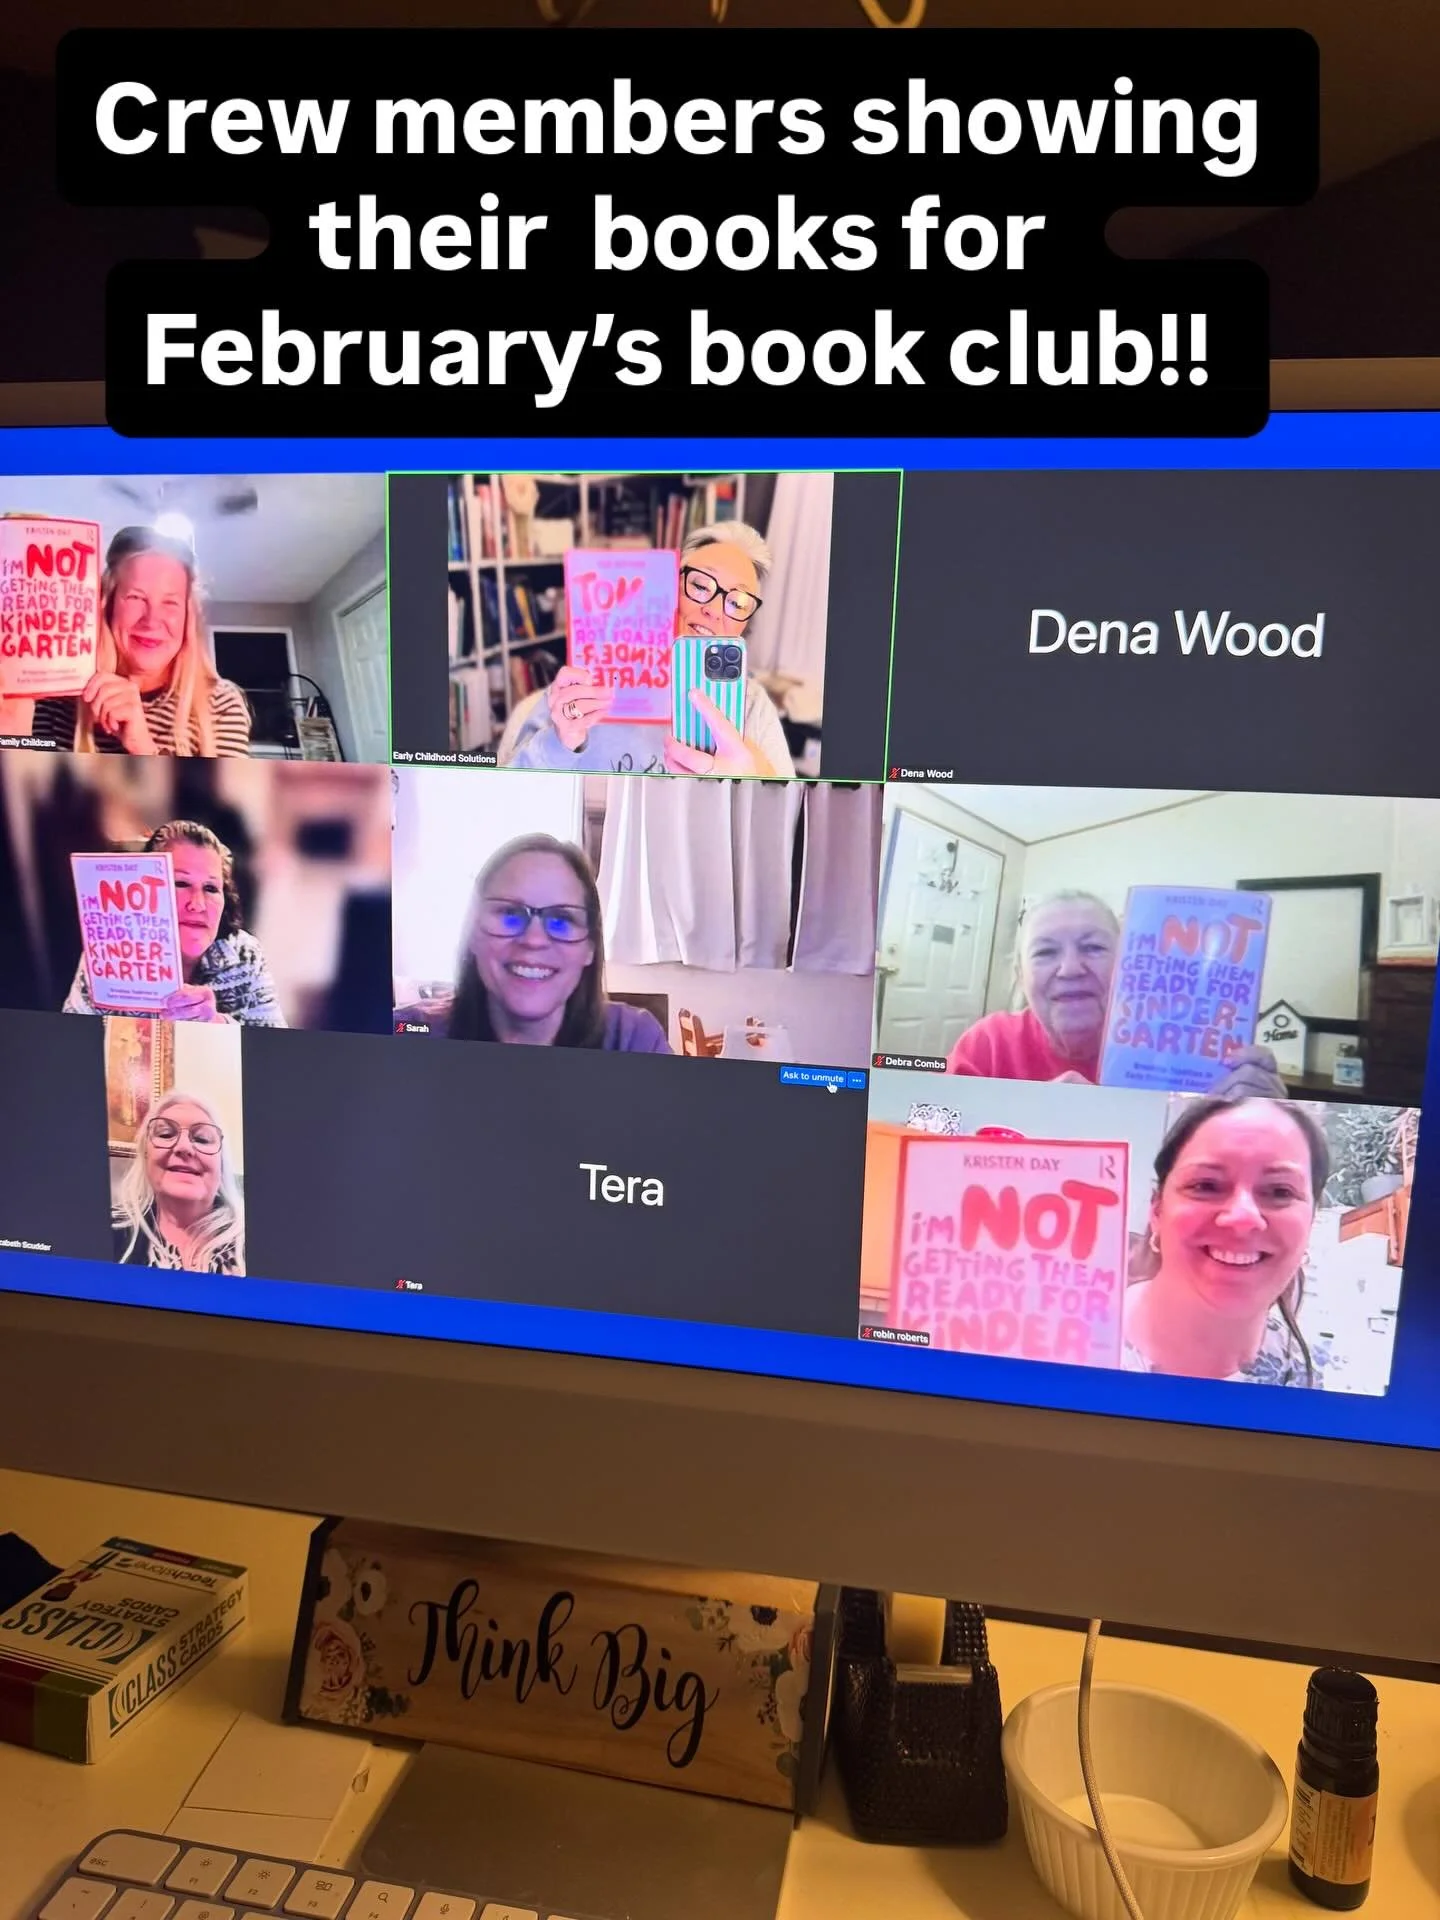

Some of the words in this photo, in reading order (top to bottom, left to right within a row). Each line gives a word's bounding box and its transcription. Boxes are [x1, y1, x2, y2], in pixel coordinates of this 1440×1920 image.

[27, 540, 95, 582] NOT
[2, 594, 58, 612] READY
[65, 595, 93, 613] FOR
[1029, 608, 1160, 655] Dena
[1174, 609, 1326, 659] Wood
[1, 634, 92, 659] GARTEN
[21, 738, 56, 747] Childcare
[393, 752, 413, 761] Early
[415, 752, 456, 762] Childhood
[458, 754, 496, 764] Solutions
[900, 768, 925, 778] Dena
[926, 769, 954, 779] Wood
[99, 875, 165, 914] NOT
[132, 912, 169, 927] THEM
[87, 926, 133, 941] READY
[140, 927, 169, 944] FOR
[1158, 912, 1264, 964] NOT
[92, 960, 173, 982] GARTEN
[1121, 974, 1199, 996] READY
[1206, 979, 1251, 1005] FOR
[406, 1024, 429, 1033] Sarah
[1113, 1017, 1244, 1061] GARTEN
[1263, 1028, 1299, 1042] Home
[885, 1057, 912, 1067] Debra
[914, 1059, 946, 1069] Combs
[783, 1071, 799, 1080] Ask
[801, 1072, 809, 1081] to
[812, 1075, 844, 1083] unmute
[963, 1153, 1025, 1170] KRISTEN
[1029, 1157, 1060, 1172] DAY
[579, 1163, 664, 1207] Tera
[960, 1180, 1120, 1261] NOT
[22, 1240, 52, 1251] Scudder
[1030, 1253, 1115, 1291] THEM
[405, 1280, 423, 1290] Tera
[907, 1279, 1027, 1315] READY
[1040, 1285, 1110, 1324] FOR
[872, 1330, 896, 1341] robin
[897, 1331, 929, 1344] roberts
[134, 1559, 218, 1588] Teachstone
[74, 1599, 170, 1628] STRATEGY
[119, 1598, 180, 1619] CARDS
[2, 1602, 125, 1650] CLASS
[123, 1643, 177, 1714] CLASS
[178, 1586, 244, 1650] STRATEGY
[179, 1621, 223, 1667] CARDS
[408, 1579, 577, 1704] Think
[591, 1623, 720, 1768] Big
[89, 1857, 108, 1867] esc
[189, 1877, 199, 1885] F1
[248, 1888, 258, 1897] F2
[368, 1910, 379, 1920] F4
